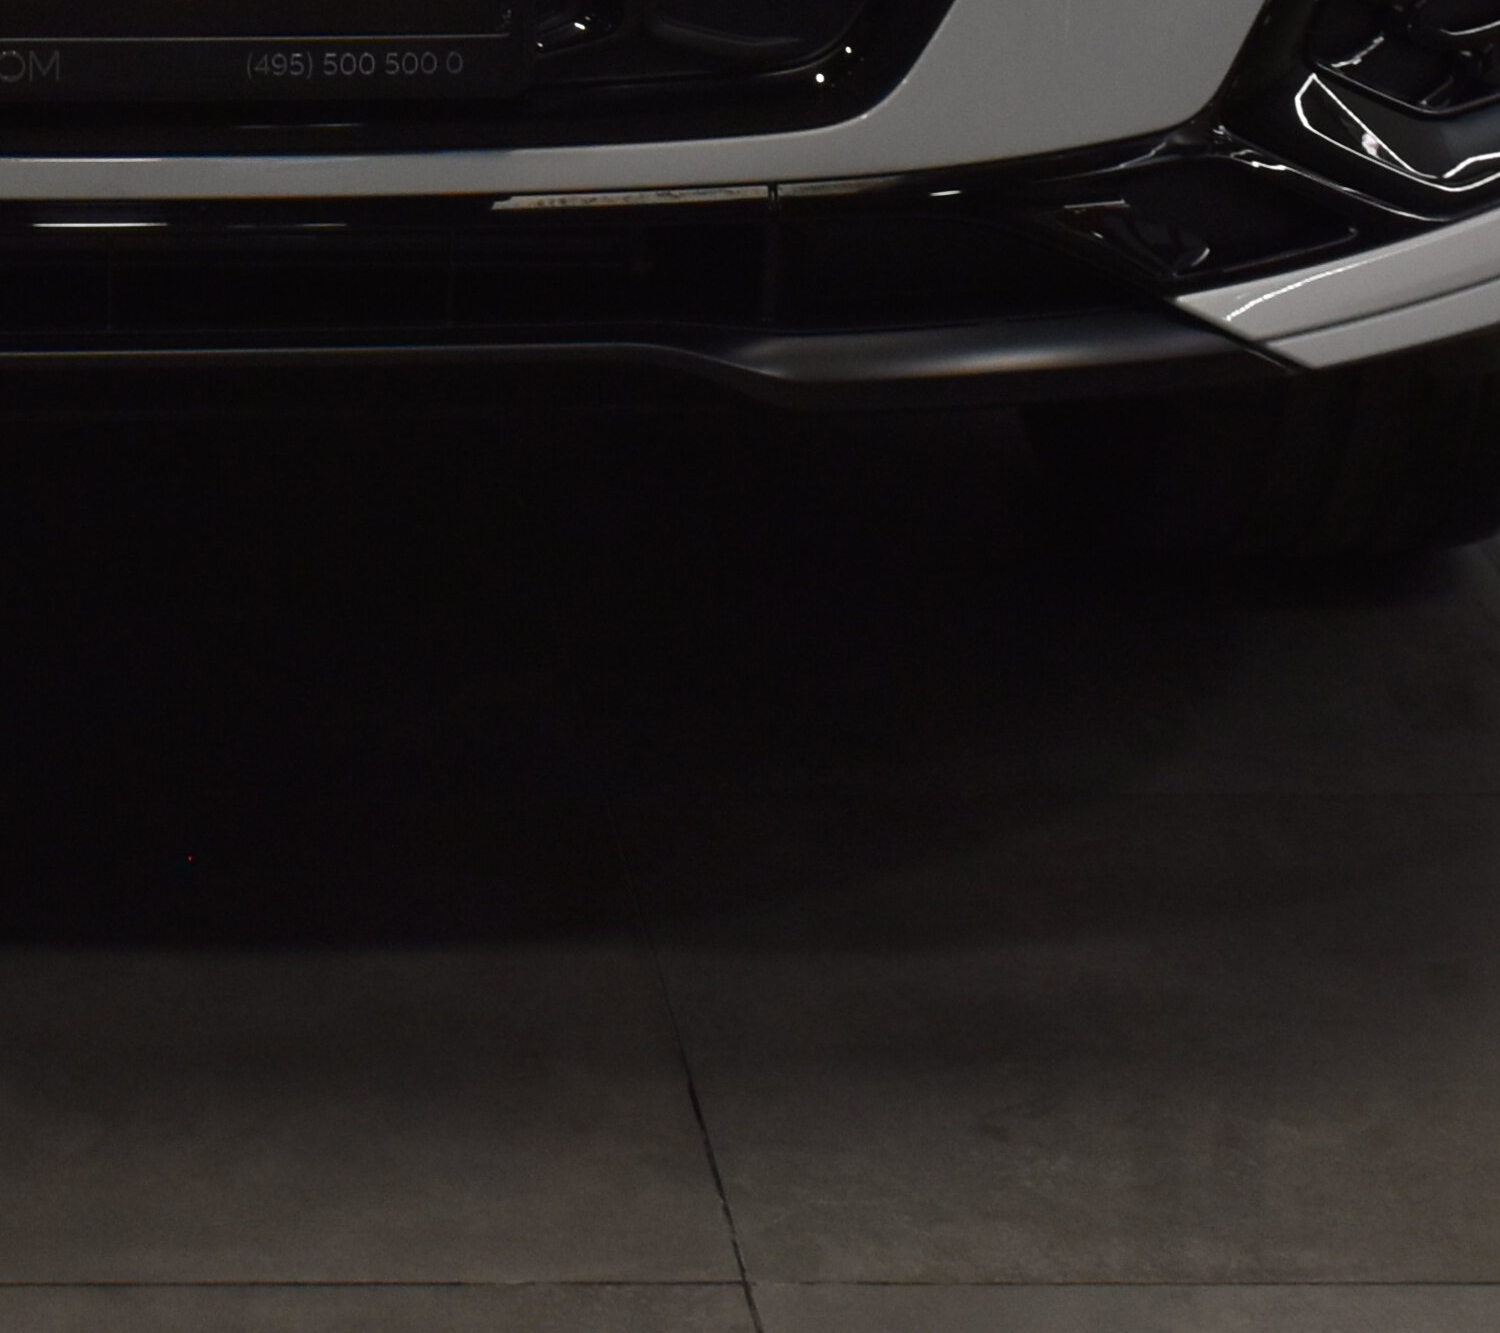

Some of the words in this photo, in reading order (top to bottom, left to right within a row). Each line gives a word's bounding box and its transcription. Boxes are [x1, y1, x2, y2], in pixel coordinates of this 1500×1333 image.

[246, 51, 314, 79] (495)
[322, 51, 376, 76] 500
[384, 50, 438, 75] 500
[446, 50, 464, 75] 0
